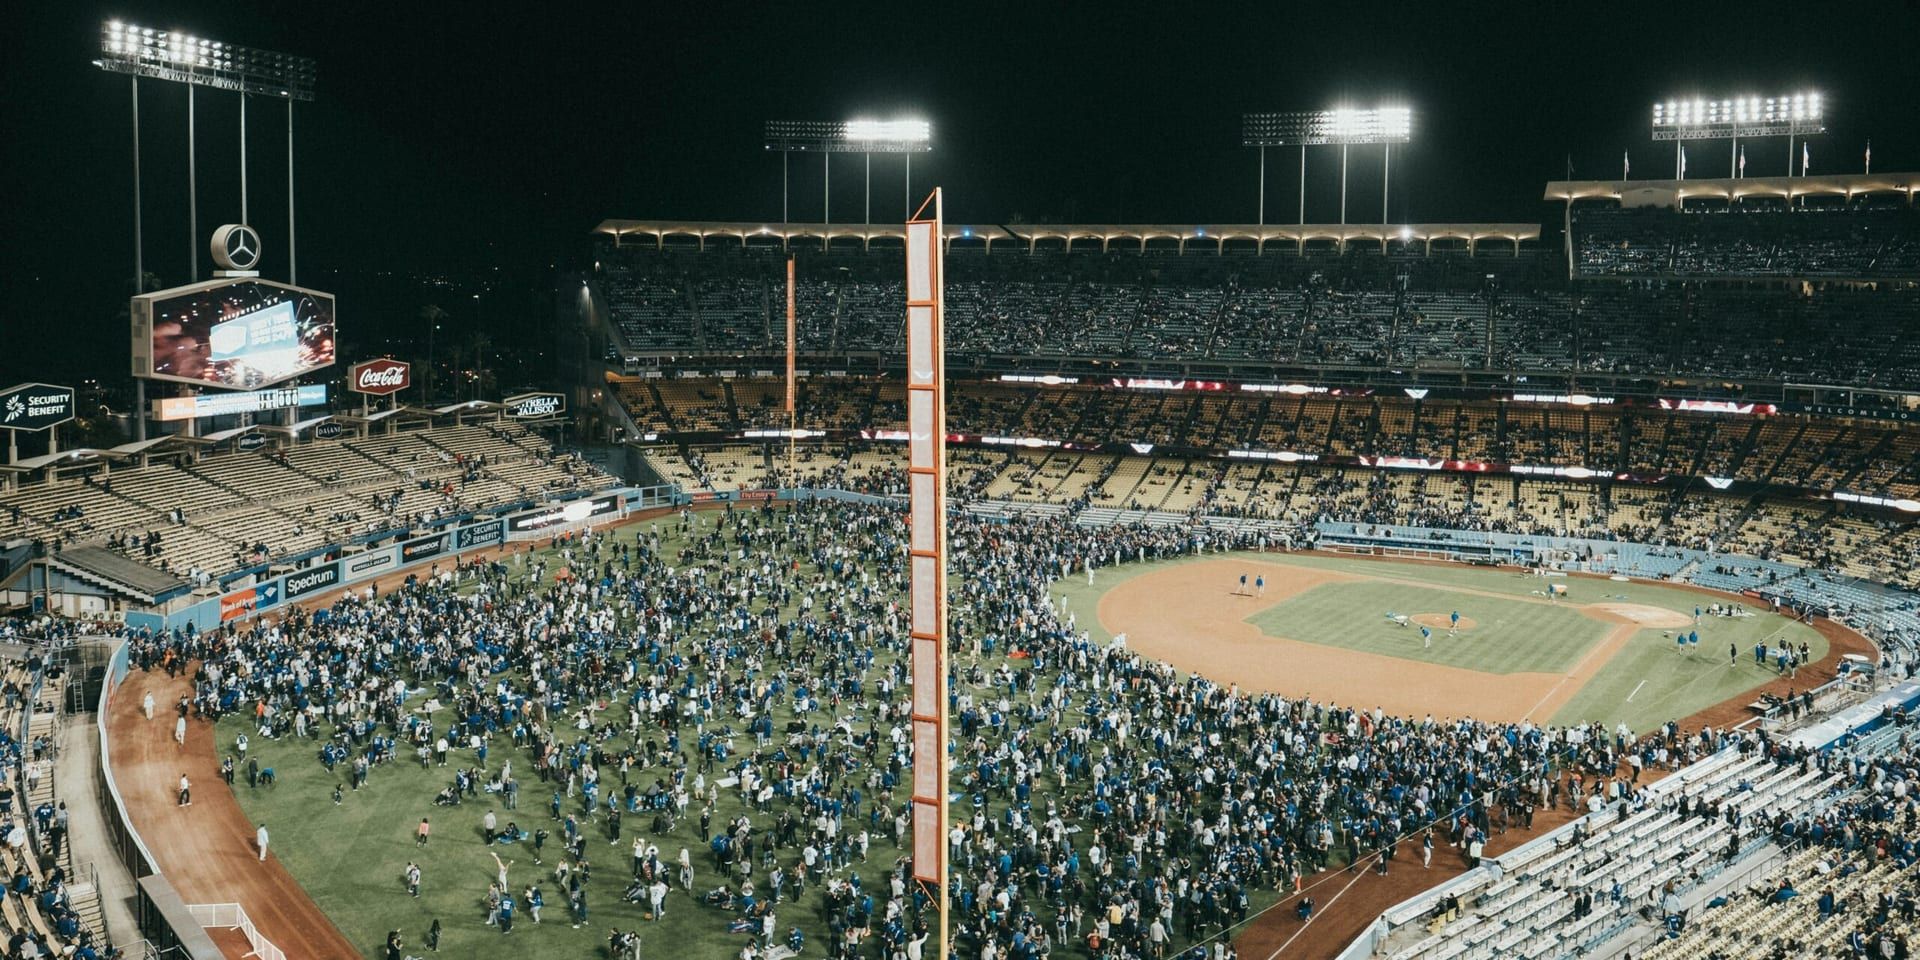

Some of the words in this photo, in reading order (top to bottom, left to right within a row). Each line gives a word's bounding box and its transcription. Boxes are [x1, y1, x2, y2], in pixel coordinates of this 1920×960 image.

[359, 366, 407, 388] Coca-Cola
[28, 394, 70, 406] SECURITY
[513, 397, 559, 409] TRELLA
[28, 405, 66, 417] BENEFIT
[517, 404, 554, 416] JALISCO
[1804, 405, 1878, 417] WELCOME
[318, 426, 341, 435] DASANI
[473, 522, 501, 535] SECURITY
[473, 531, 500, 544] BENEFIT
[287, 570, 333, 594] Spectrum
